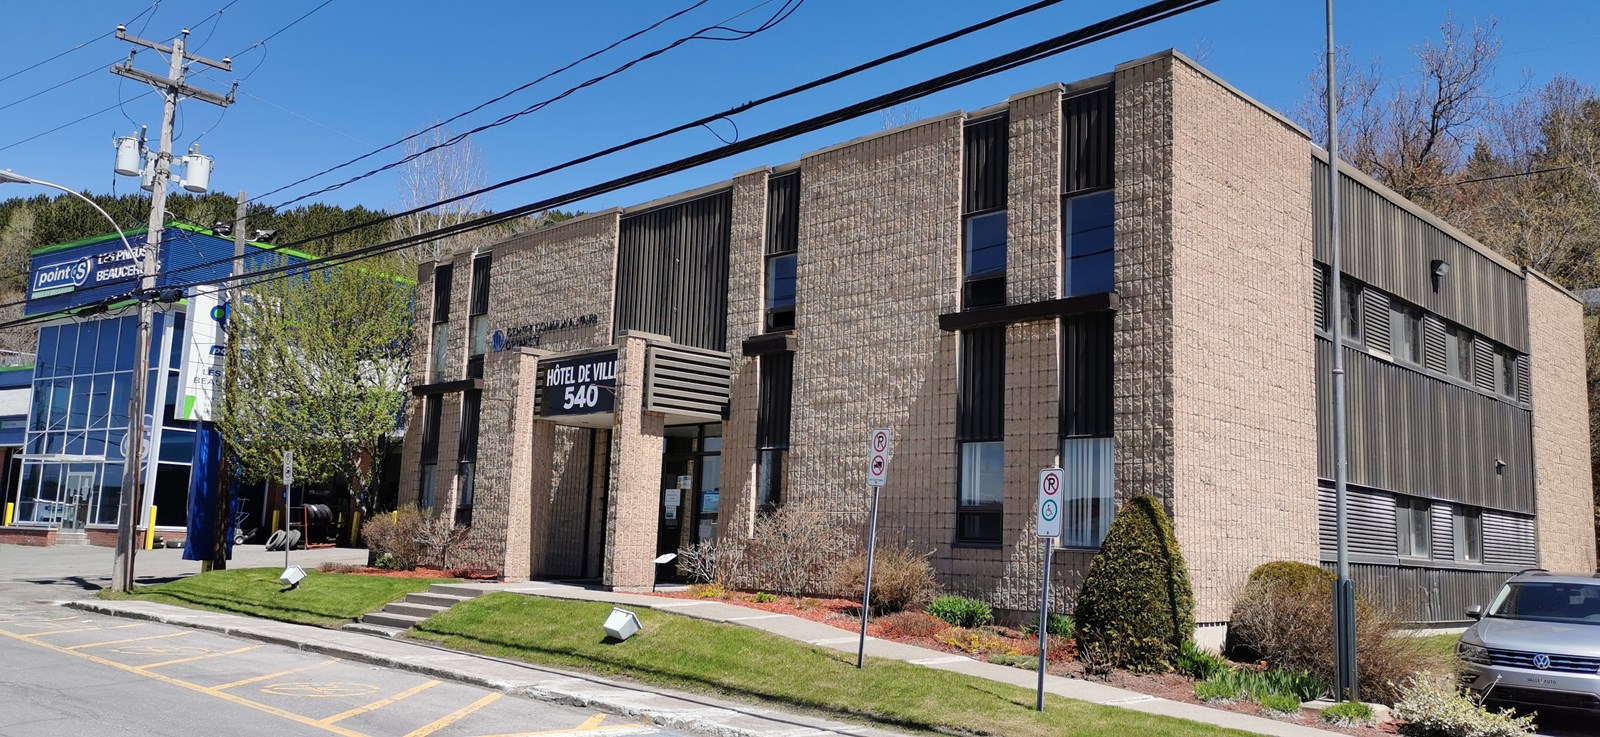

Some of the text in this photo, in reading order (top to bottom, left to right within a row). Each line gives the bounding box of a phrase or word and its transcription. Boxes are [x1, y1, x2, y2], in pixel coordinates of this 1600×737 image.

[38, 266, 71, 286] point
[546, 364, 575, 386] HÔTEL
[578, 364, 591, 383] DE
[563, 384, 599, 409] 540
